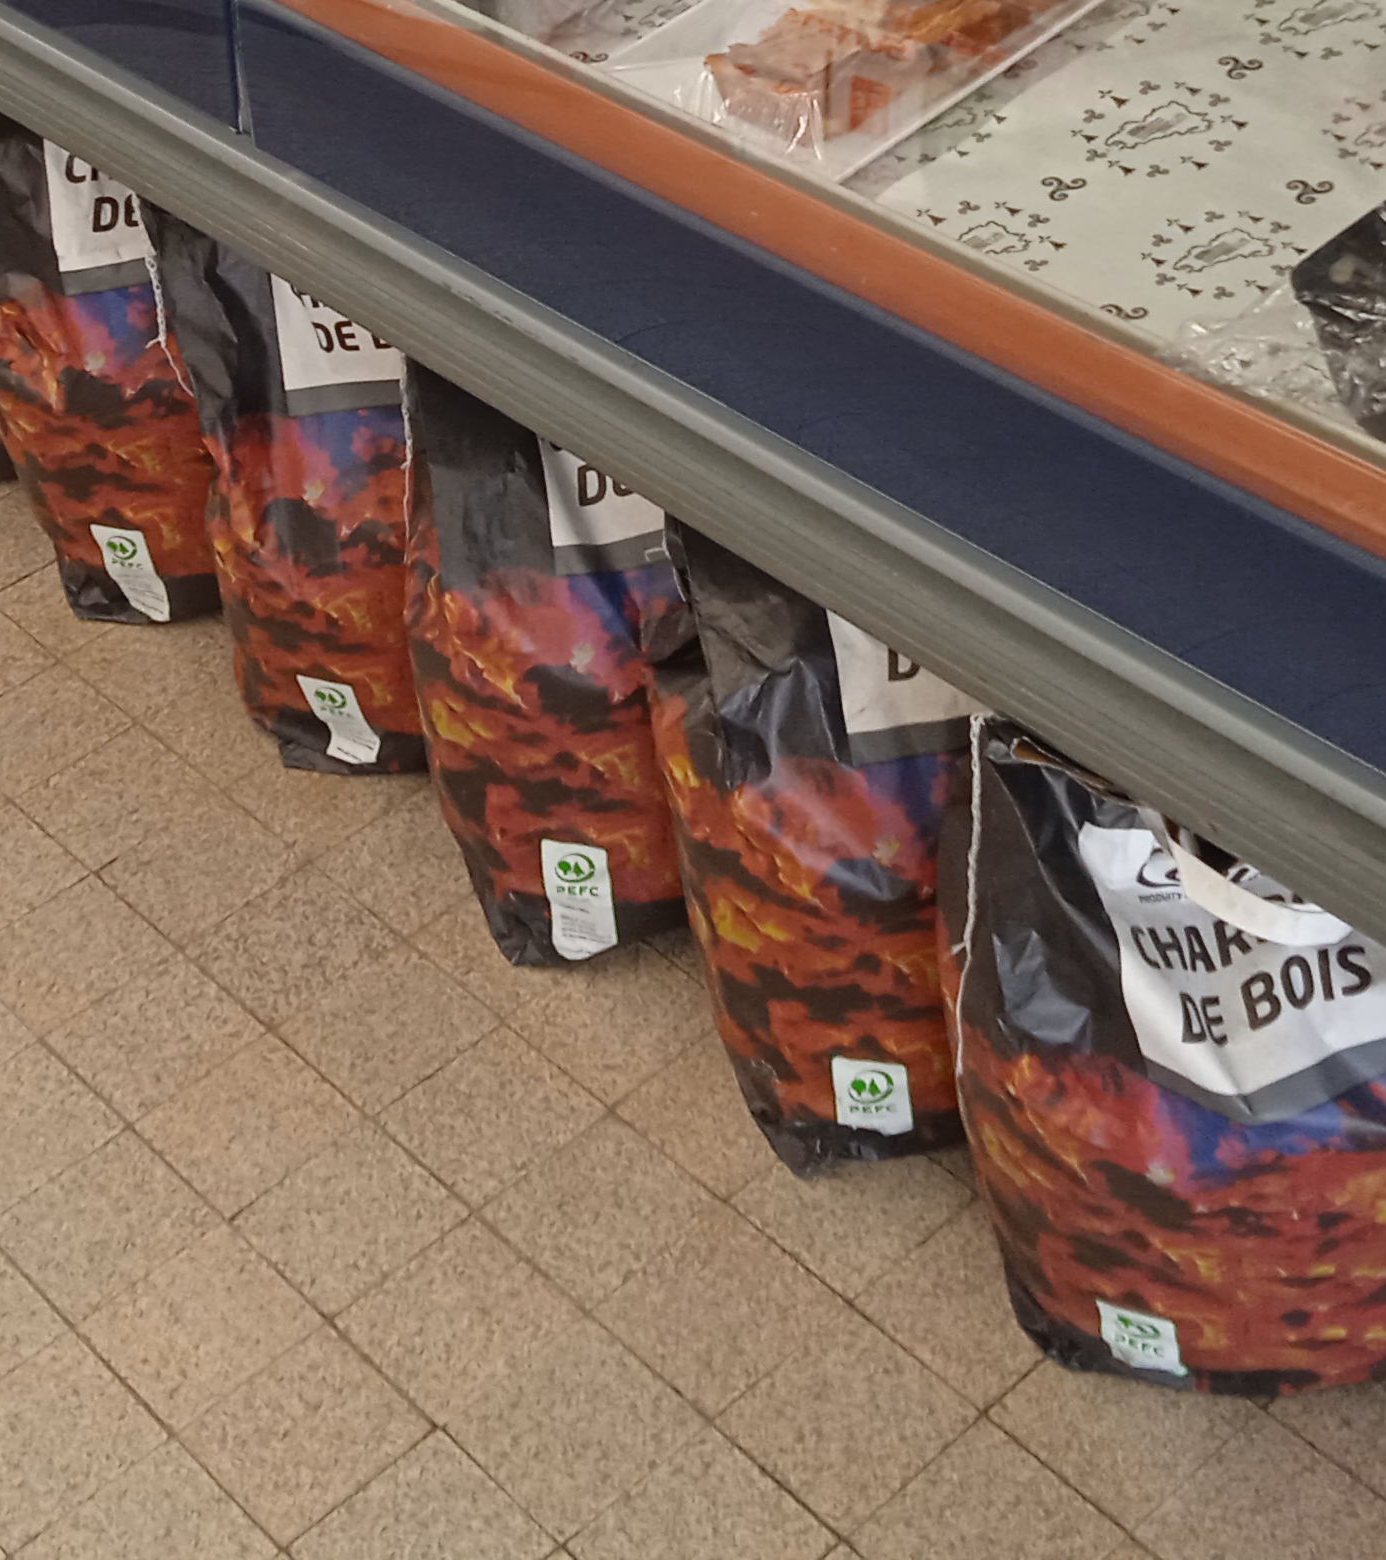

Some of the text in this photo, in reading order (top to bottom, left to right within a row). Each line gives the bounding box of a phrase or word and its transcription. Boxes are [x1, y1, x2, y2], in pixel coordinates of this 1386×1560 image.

[556, 885, 600, 897] PEFC
[1179, 944, 1373, 1046] DE BOIS
